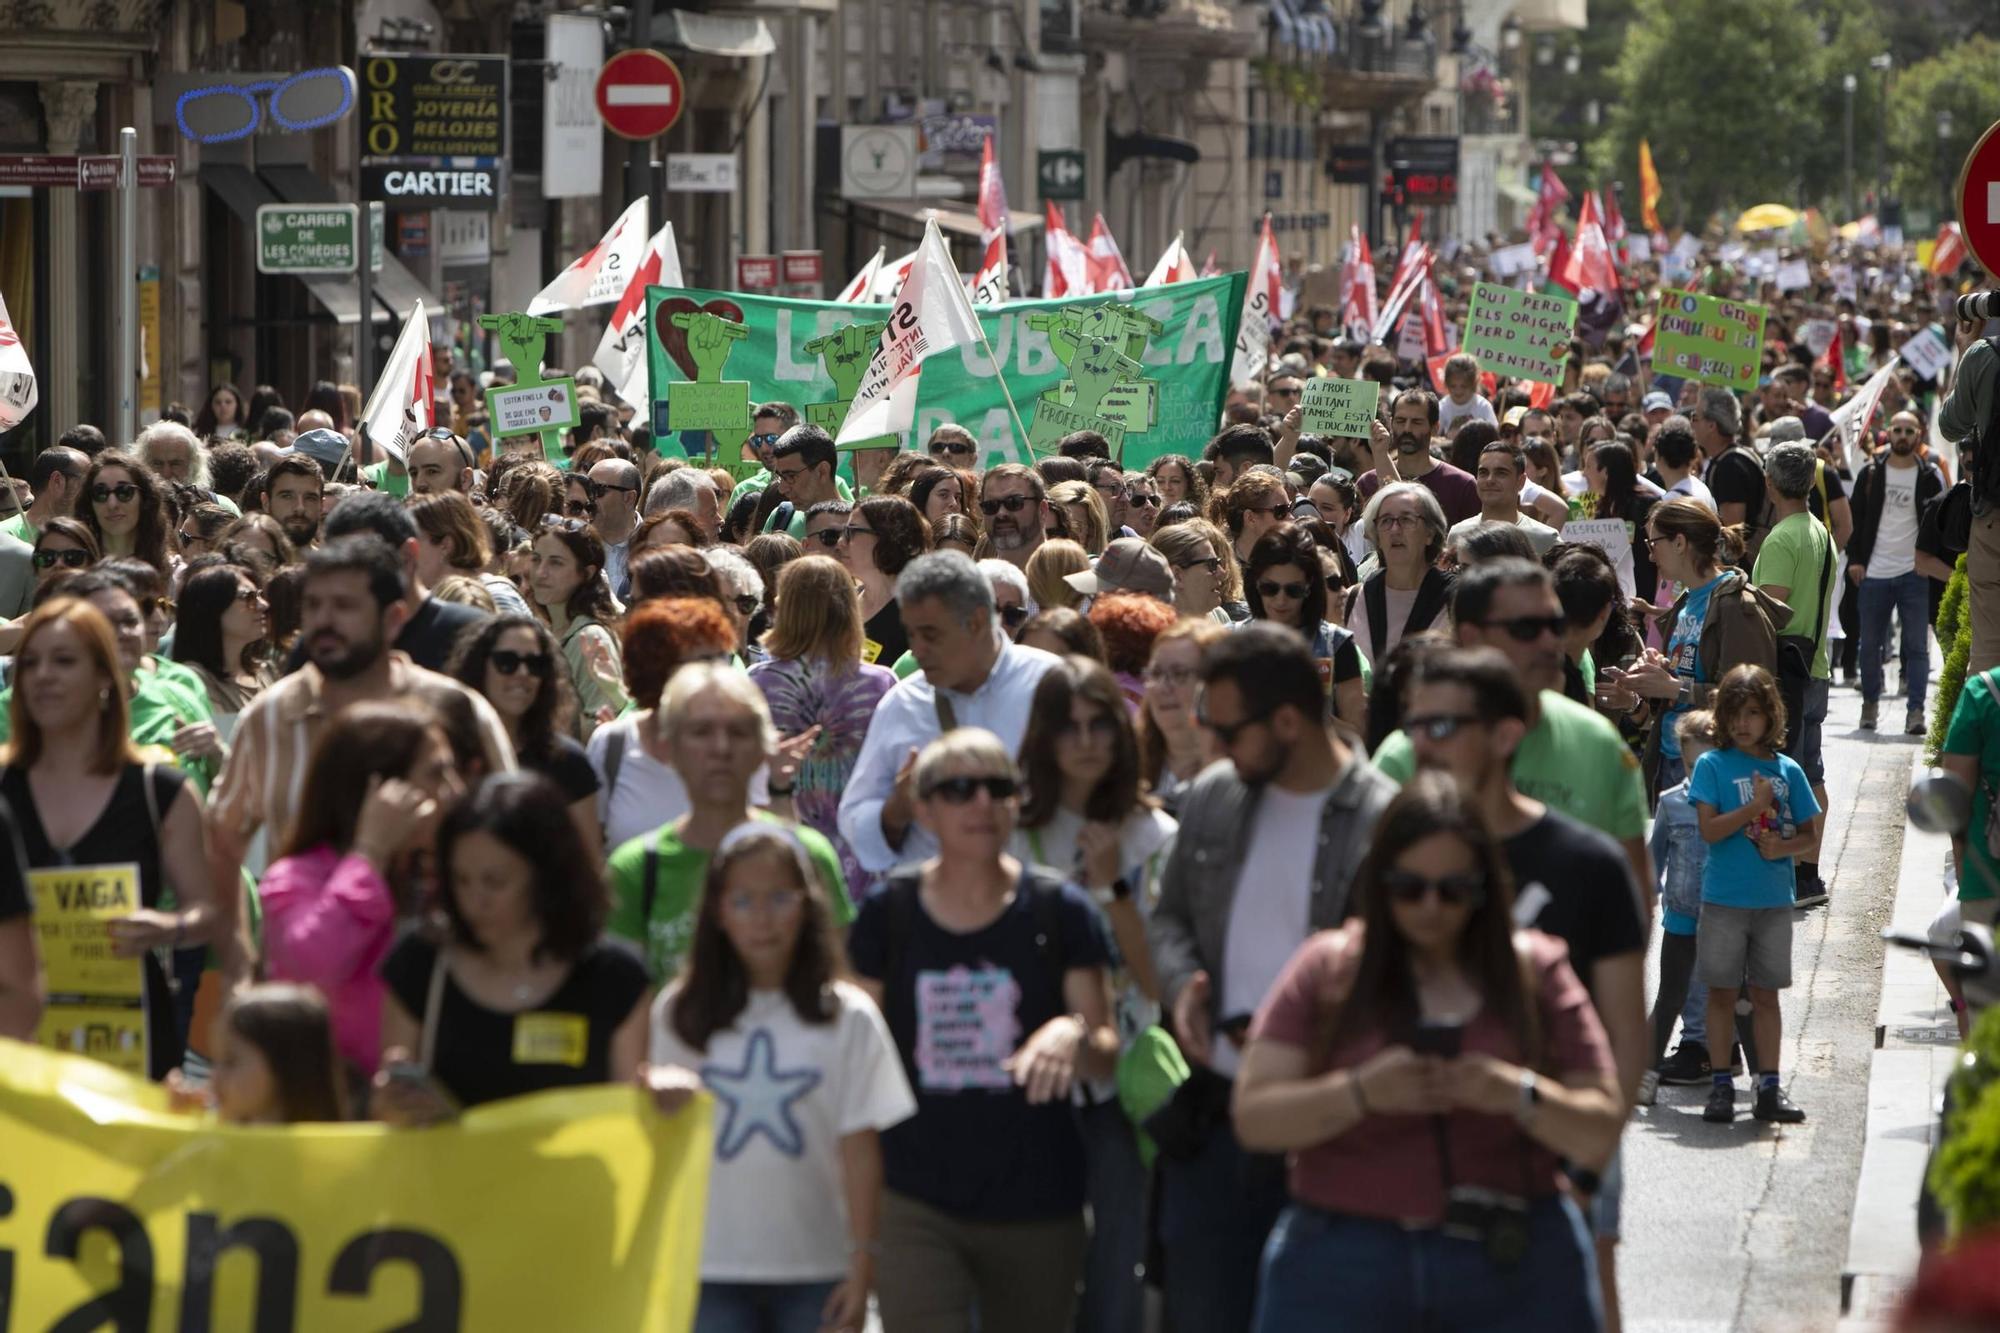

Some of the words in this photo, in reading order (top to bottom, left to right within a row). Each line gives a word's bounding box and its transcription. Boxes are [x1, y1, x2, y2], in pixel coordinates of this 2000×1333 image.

[367, 57, 399, 155] ORO
[413, 97, 498, 117] JOYERÍA
[413, 121, 498, 137] RELOJES
[384, 170, 493, 196] CARTIER
[286, 213, 347, 228] CARRER
[298, 230, 315, 242] DE
[264, 244, 287, 258] LES
[1477, 287, 1506, 304] QUI
[1522, 297, 1562, 313] PERD
[1475, 307, 1502, 321] ELS
[1511, 311, 1574, 338] ORIGENS
[1474, 325, 1515, 340] PERD
[1529, 335, 1548, 347] LA
[1476, 347, 1563, 377] IDENTITAT
[1322, 382, 1352, 394] PROFE
[522, 394, 535, 403] FINS
[1302, 395, 1352, 409] LLUITANT
[525, 408, 536, 416] ENS
[1302, 407, 1336, 419] TAMBÉ
[1344, 409, 1372, 422] ESTÀ
[1040, 403, 1123, 442] PROFESSORAT
[1317, 421, 1366, 433] EDUCANT
[1566, 523, 1621, 536] RESPECTEM
[54, 879, 128, 911] VAGA
